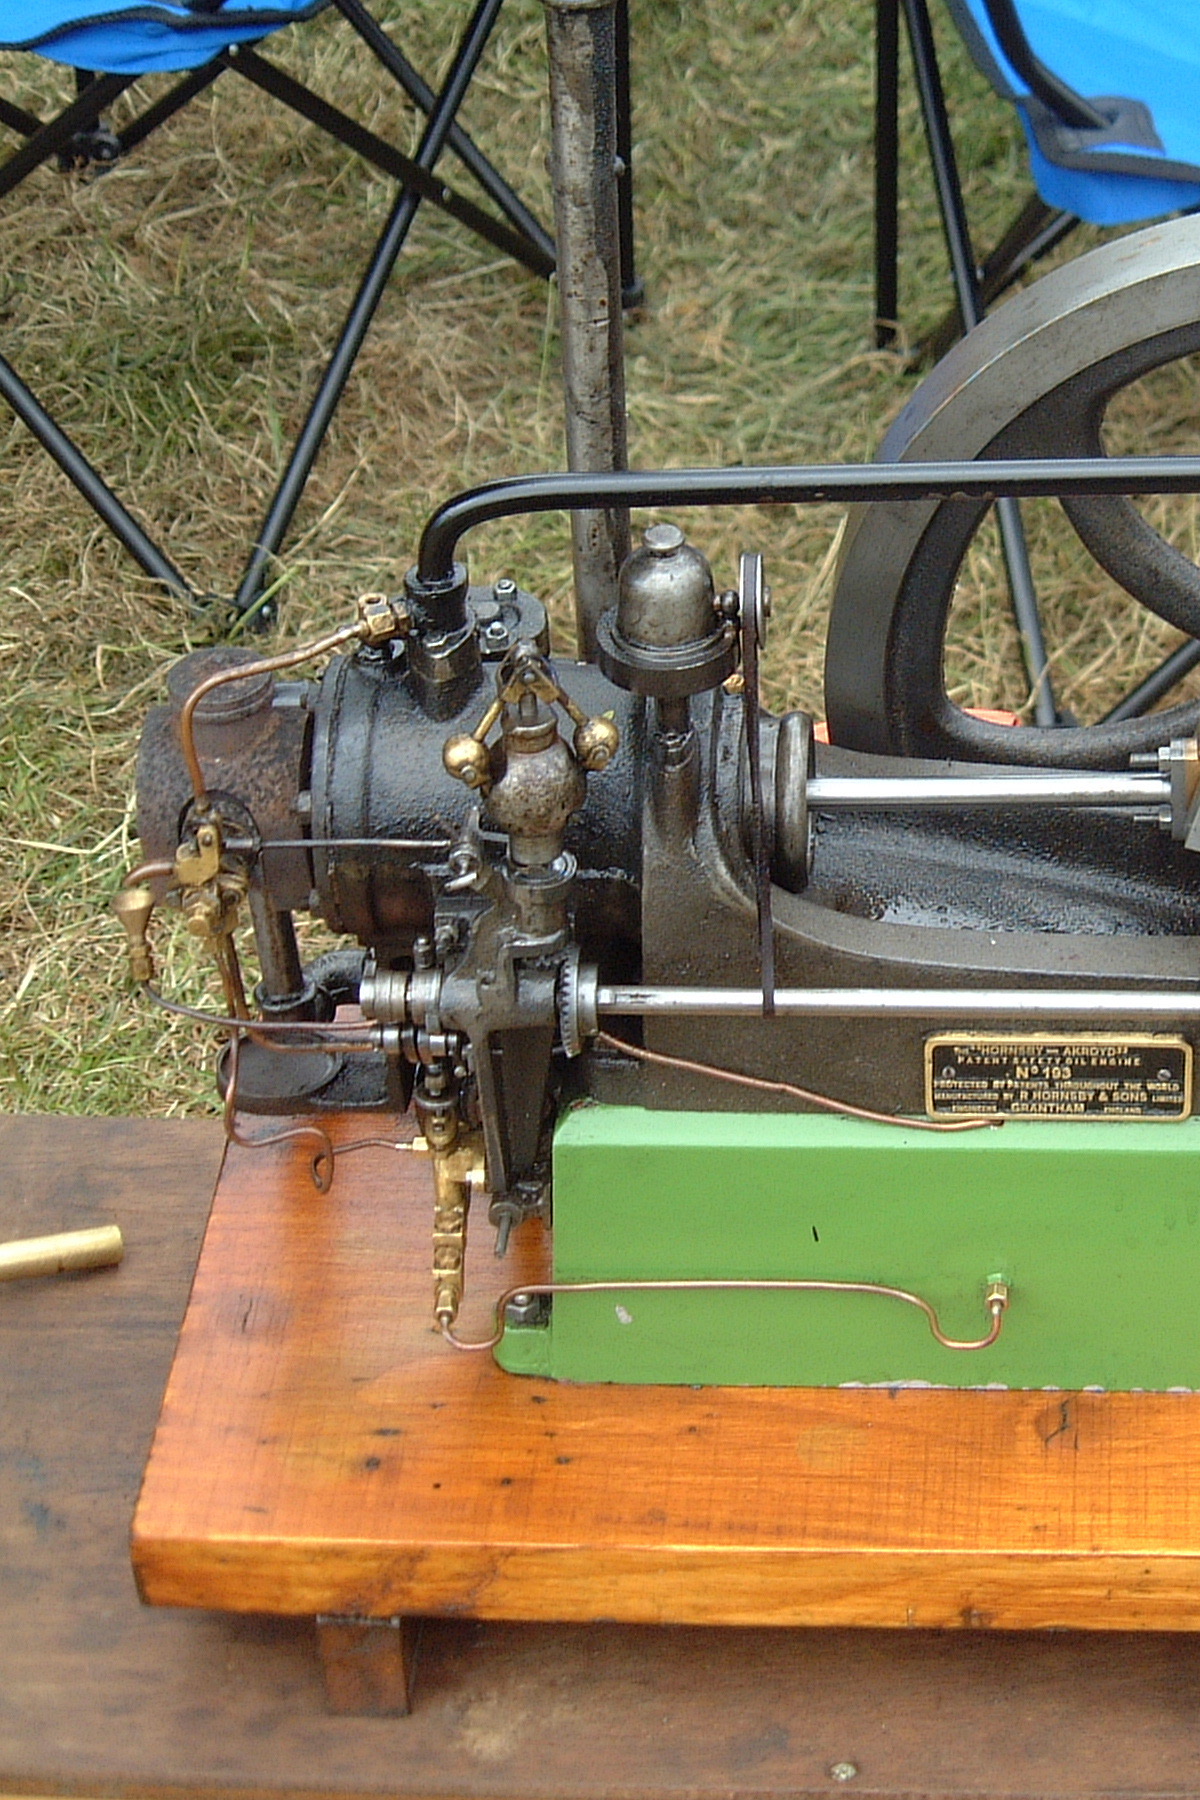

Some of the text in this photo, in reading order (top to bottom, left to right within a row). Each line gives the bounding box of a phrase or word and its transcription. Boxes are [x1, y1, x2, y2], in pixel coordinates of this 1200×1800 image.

[957, 1056, 1141, 1067] PATENT SAFETY OIL ENGINE
[934, 1080, 988, 1090] PROTECTED
[1054, 1081, 1119, 1091] THROUGHOUT
[1123, 1082, 1143, 1091] THE
[1147, 1081, 1180, 1092] WORLD
[1032, 1091, 1096, 1103] HORNSBY
[1098, 1091, 1109, 1103] &
[1112, 1091, 1148, 1103] SONS
[1010, 1102, 1086, 1114] GRANTHAM
